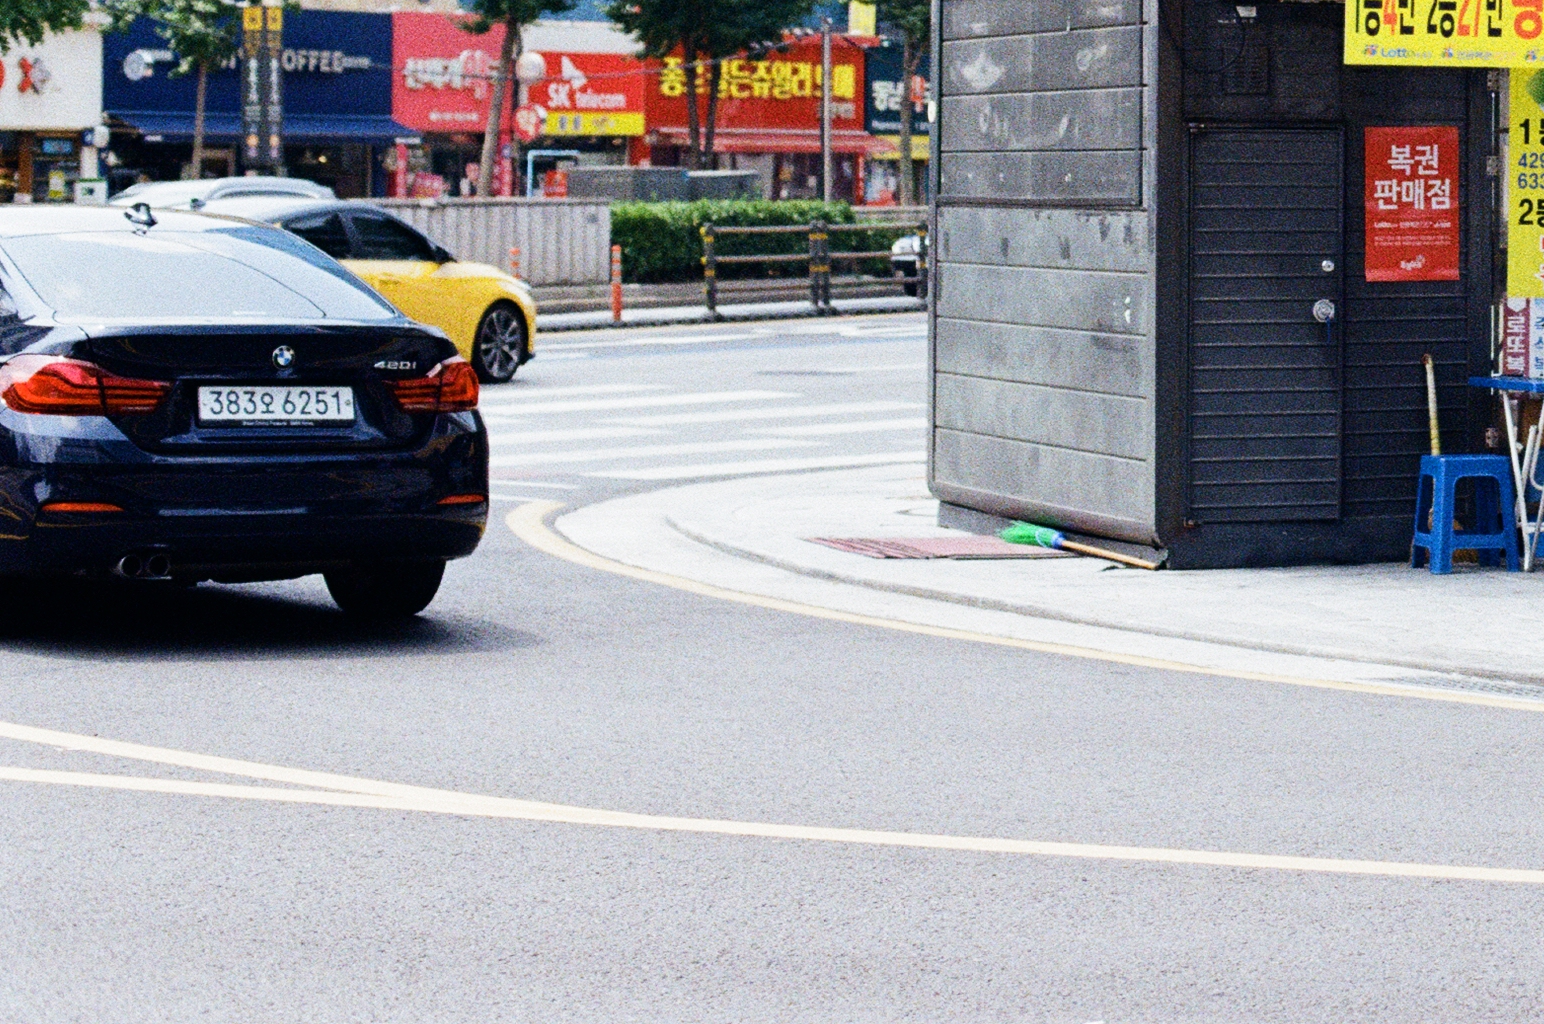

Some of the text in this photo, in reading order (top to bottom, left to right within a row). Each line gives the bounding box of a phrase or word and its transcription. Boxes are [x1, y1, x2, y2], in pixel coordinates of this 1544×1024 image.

[548, 82, 571, 108] SK
[1386, 143, 1439, 176] 복권
[1374, 178, 1451, 210] 판매점
[209, 390, 342, 416] 383오 6251
